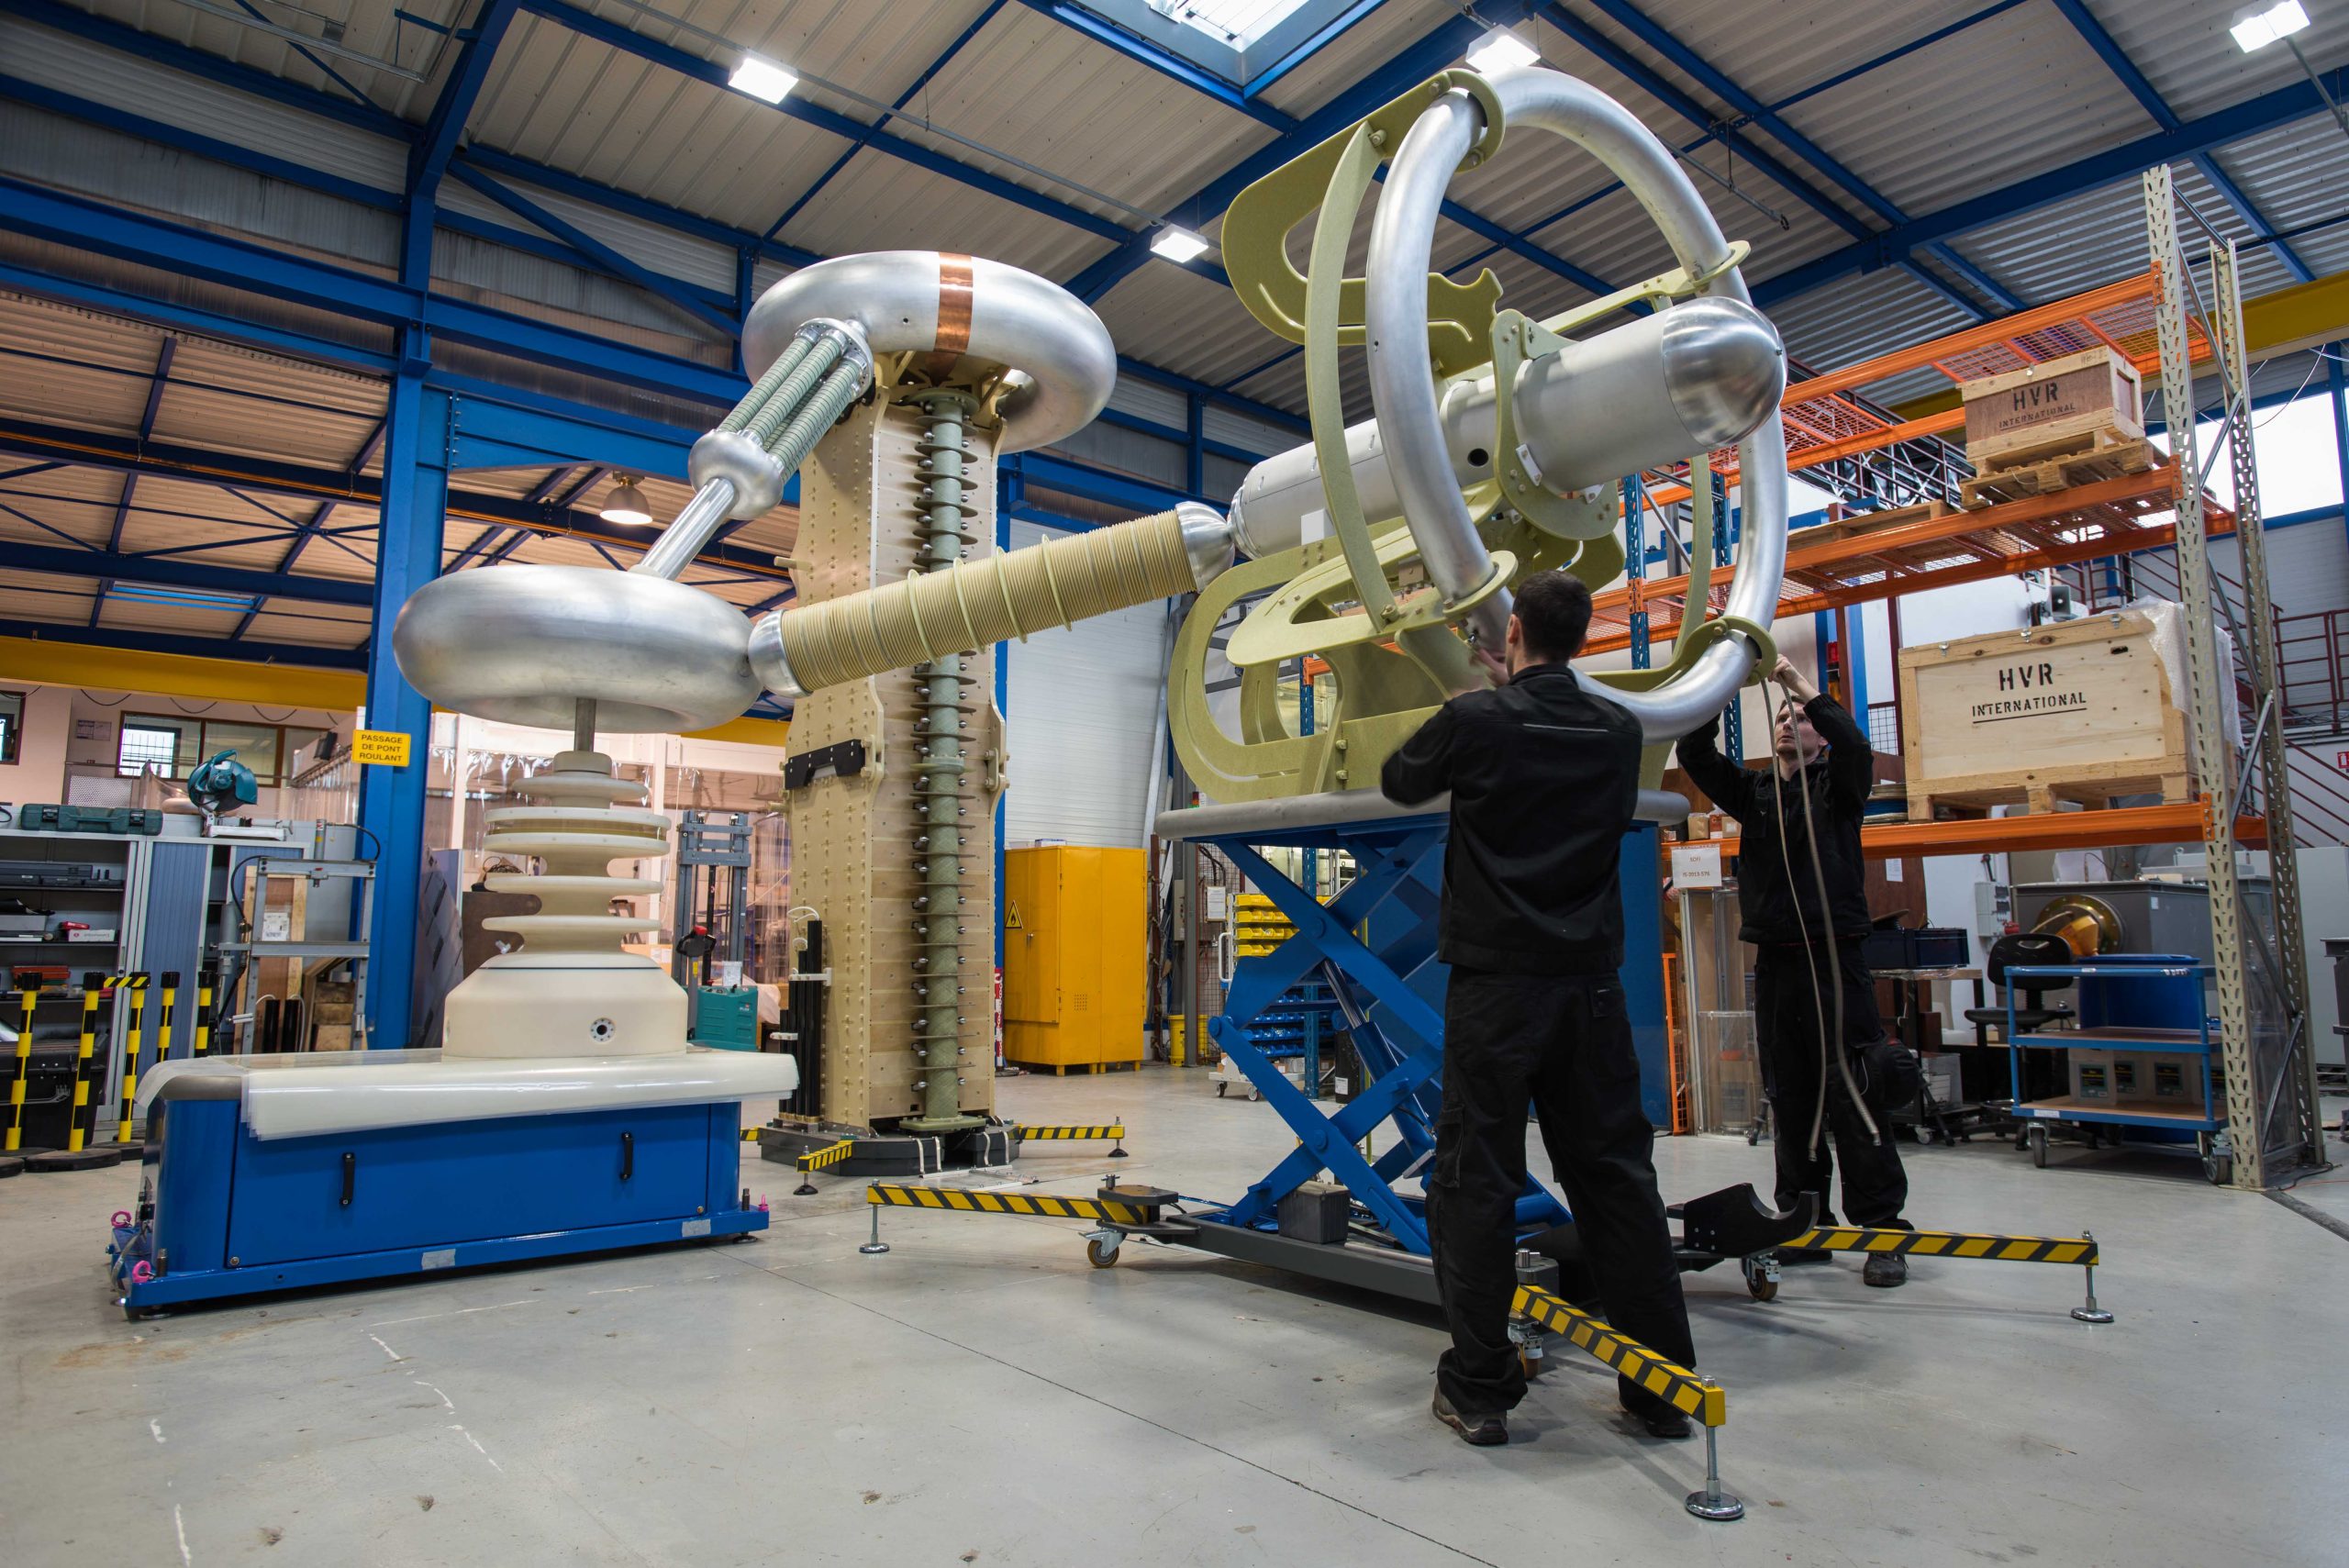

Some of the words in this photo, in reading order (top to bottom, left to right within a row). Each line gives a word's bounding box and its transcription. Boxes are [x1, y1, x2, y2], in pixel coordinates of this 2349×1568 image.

[2013, 382, 2058, 412] HVR
[1998, 403, 2076, 428] INTERNATIONAL
[1998, 662, 2054, 692] HVR
[1972, 692, 2087, 717] INTERNATIONAL
[361, 734, 403, 744] PASSAGE
[376, 744, 402, 752] PONT
[359, 751, 402, 762] ROULANT
